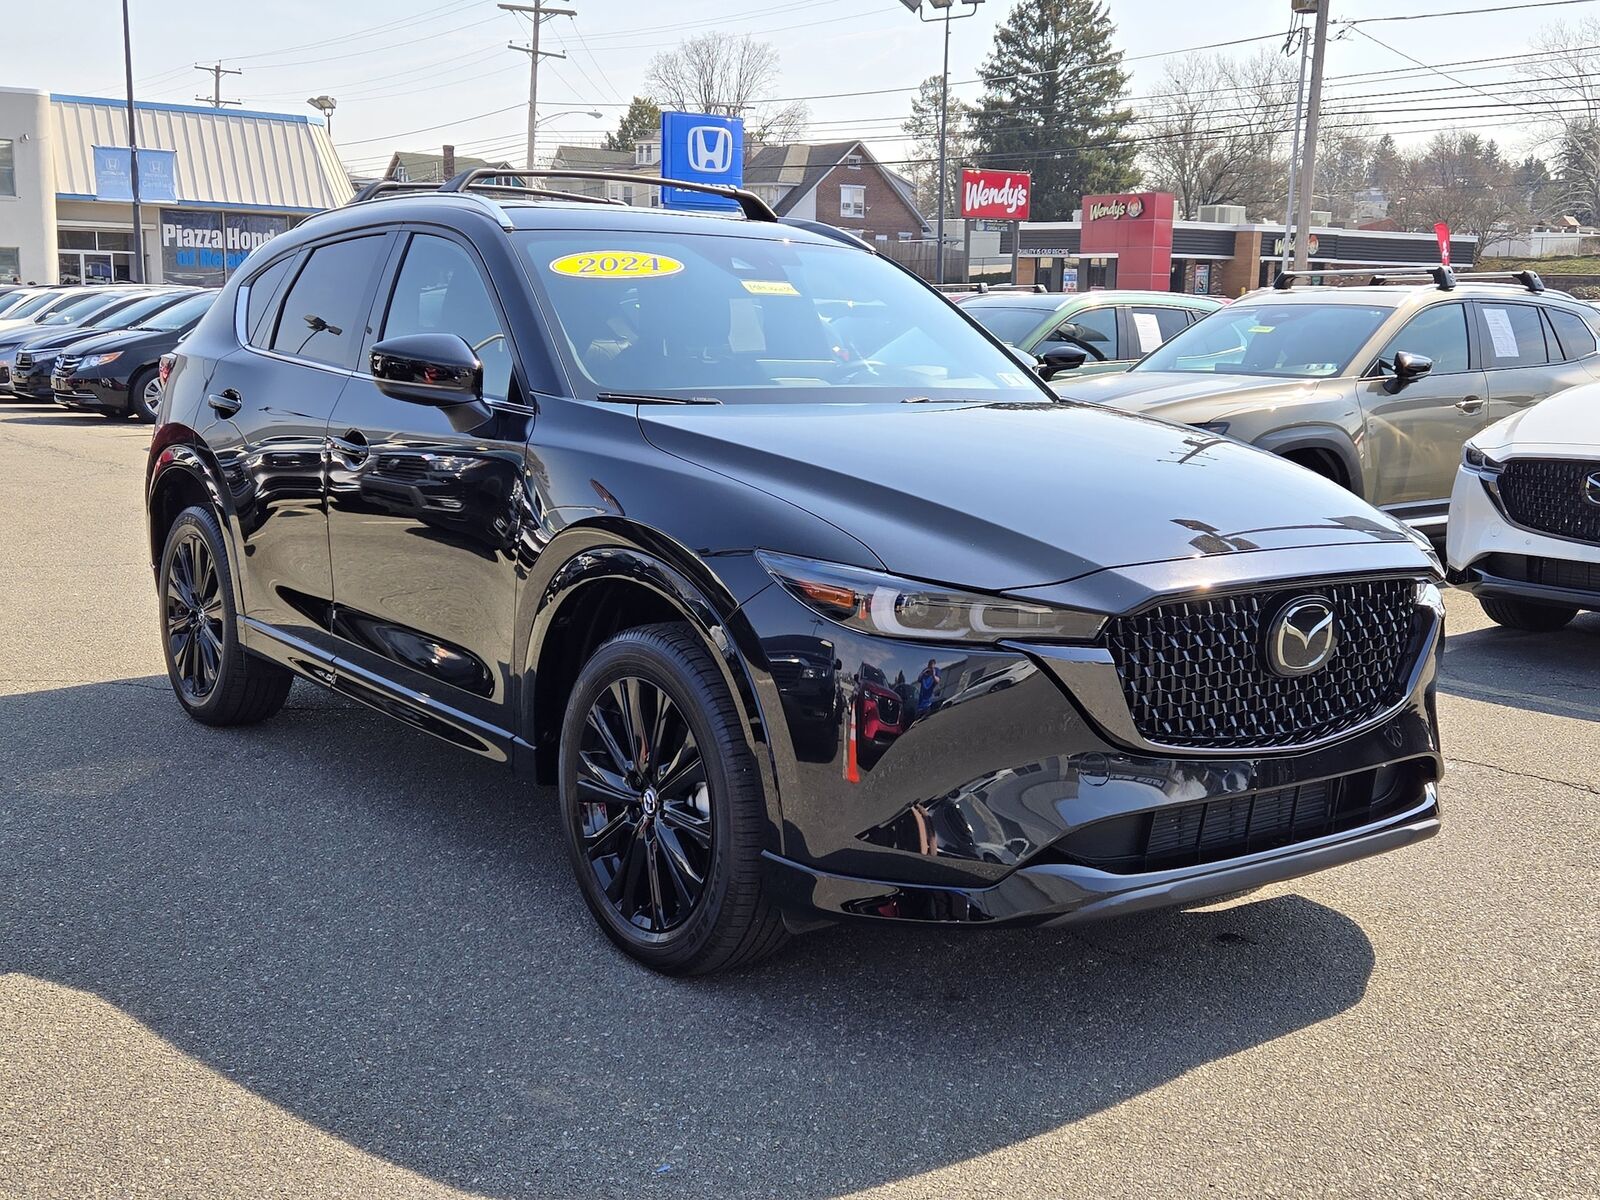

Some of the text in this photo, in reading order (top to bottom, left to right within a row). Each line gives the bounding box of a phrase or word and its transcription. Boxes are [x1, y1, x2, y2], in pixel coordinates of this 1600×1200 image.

[965, 177, 1027, 213] Wendy's
[1089, 199, 1126, 221] Wendy's
[162, 223, 275, 250] Piazza Hond
[578, 257, 661, 273] 2024
